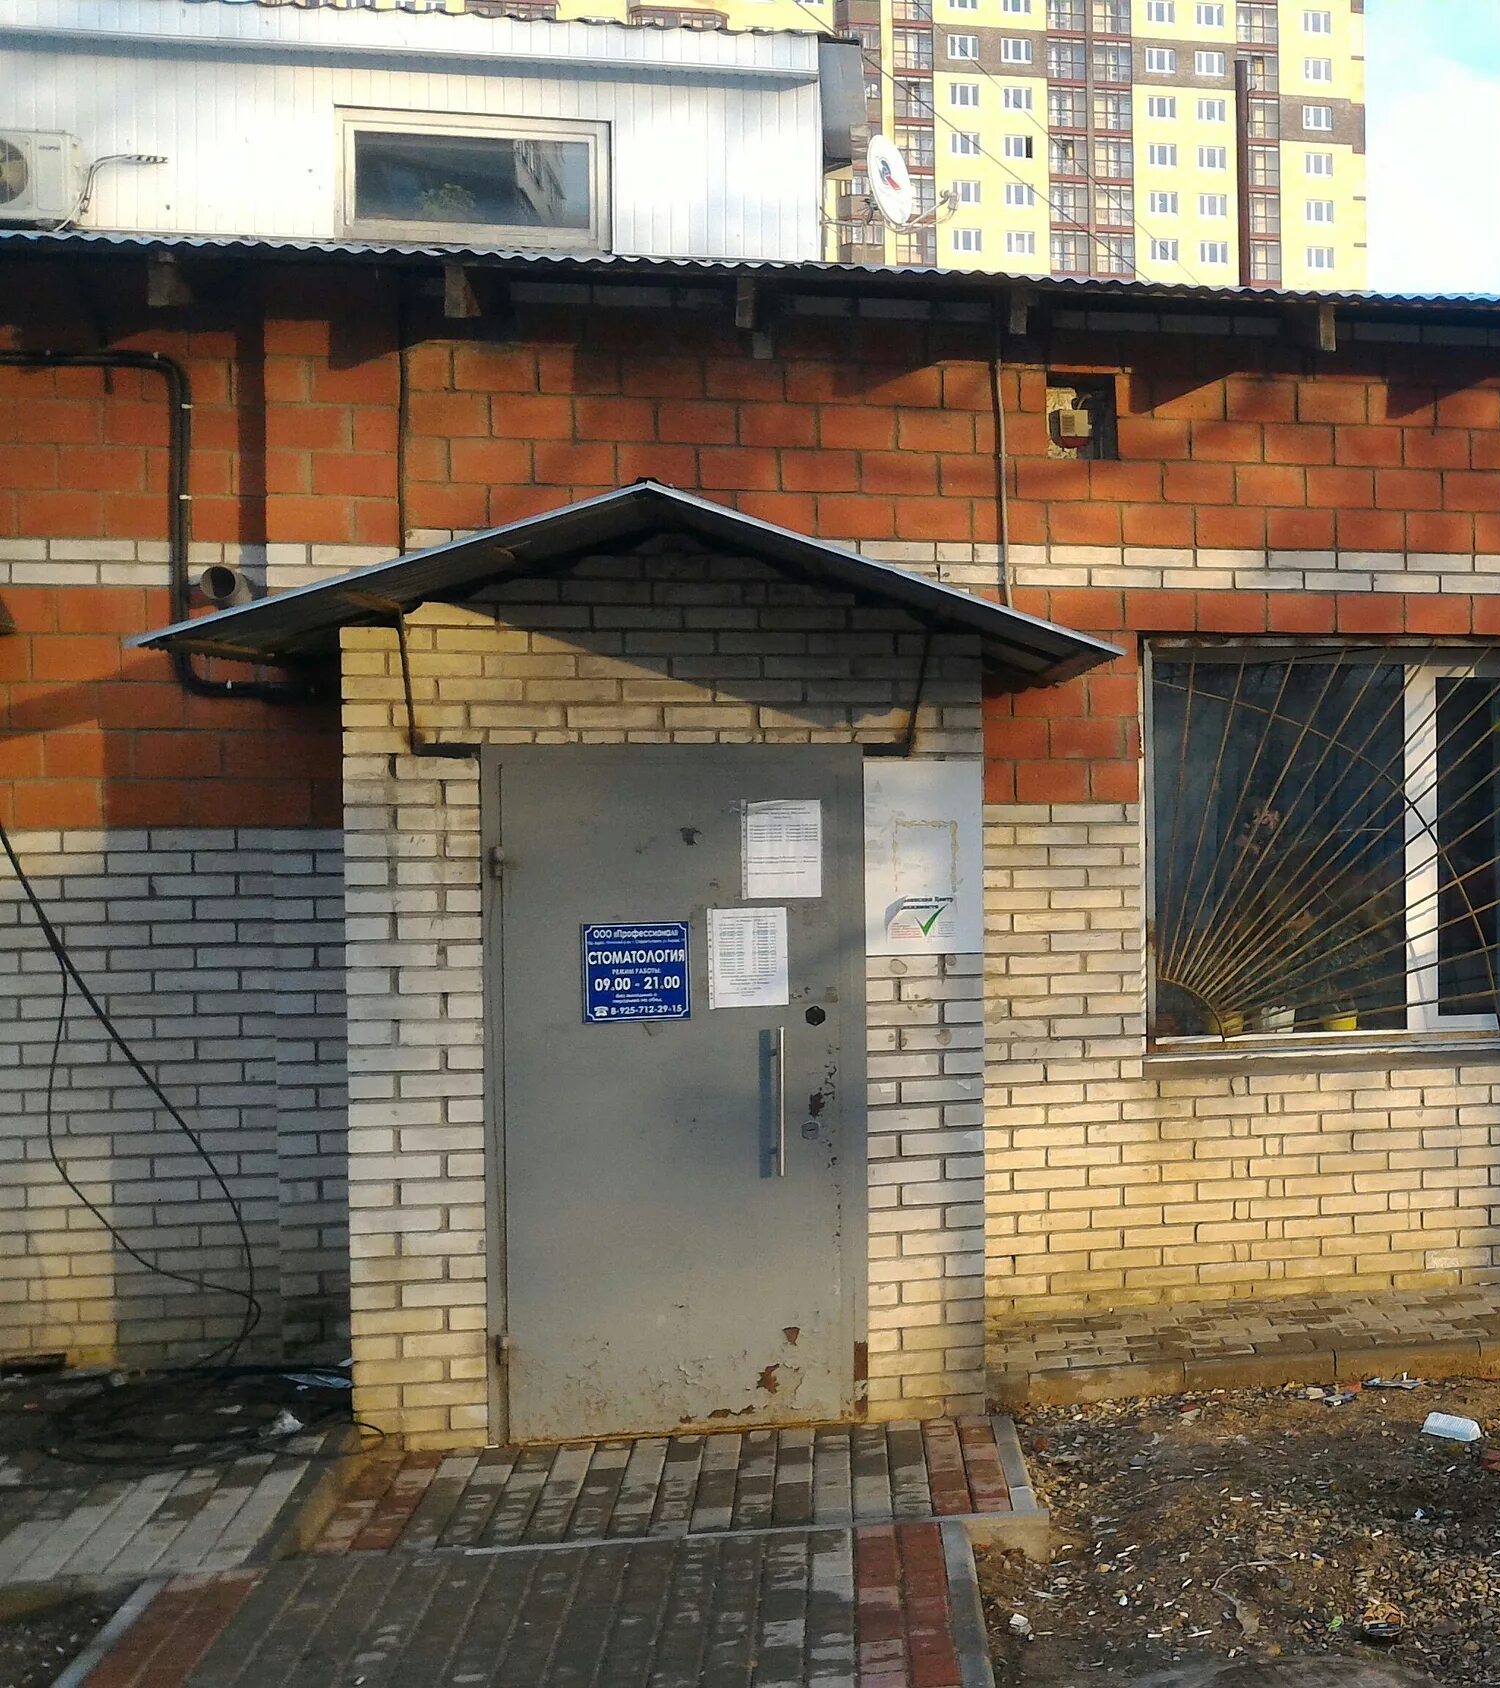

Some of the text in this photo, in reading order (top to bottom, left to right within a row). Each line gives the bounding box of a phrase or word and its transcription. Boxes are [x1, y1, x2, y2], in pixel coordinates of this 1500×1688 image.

[593, 929, 612, 939] ООО
[588, 949, 685, 965] СТОМАТОЛОГИЯ
[594, 977, 631, 991] 09.00
[643, 975, 681, 990] 21.00
[610, 1004, 683, 1016] 8-925-712-29-15
